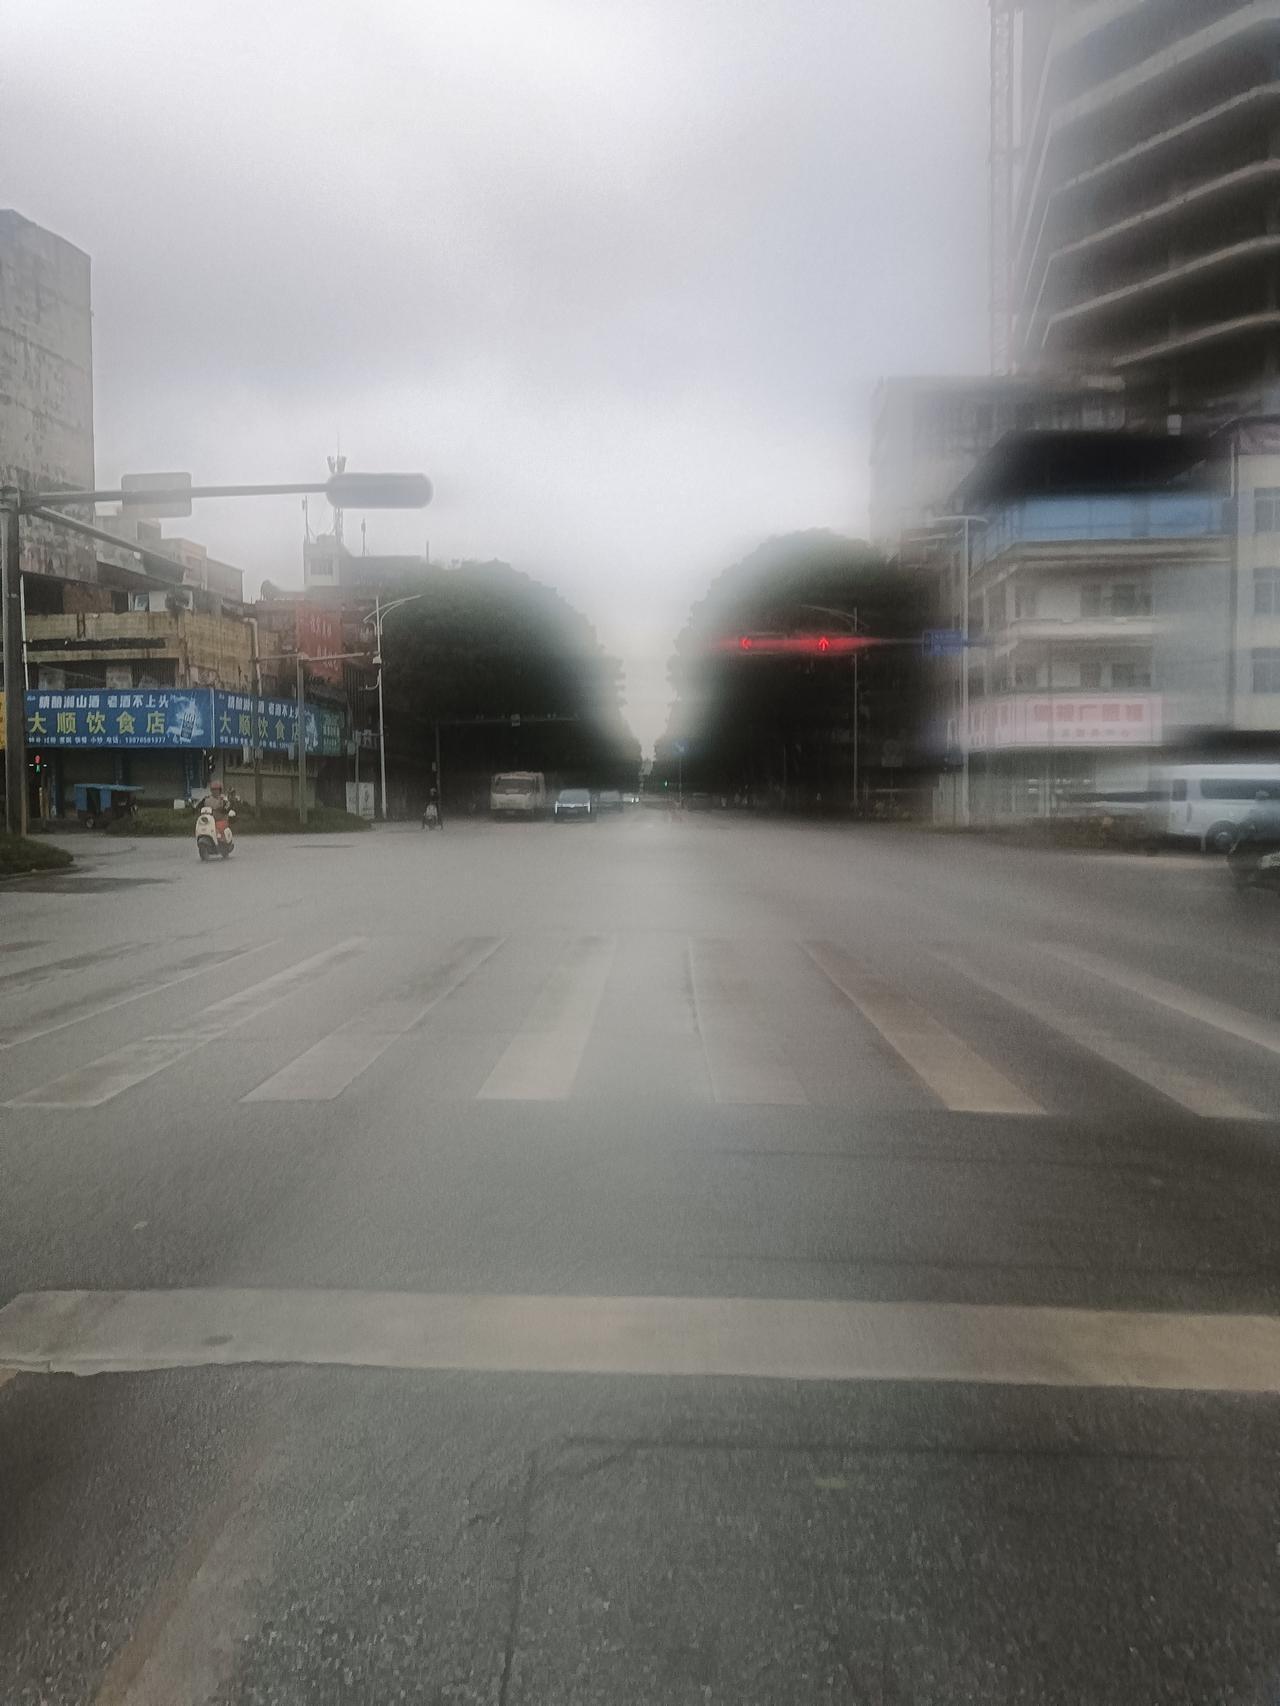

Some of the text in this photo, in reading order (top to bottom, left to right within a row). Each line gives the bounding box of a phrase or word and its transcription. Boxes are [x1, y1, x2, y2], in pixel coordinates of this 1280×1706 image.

[27, 711, 166, 735] 大顺饮食店
